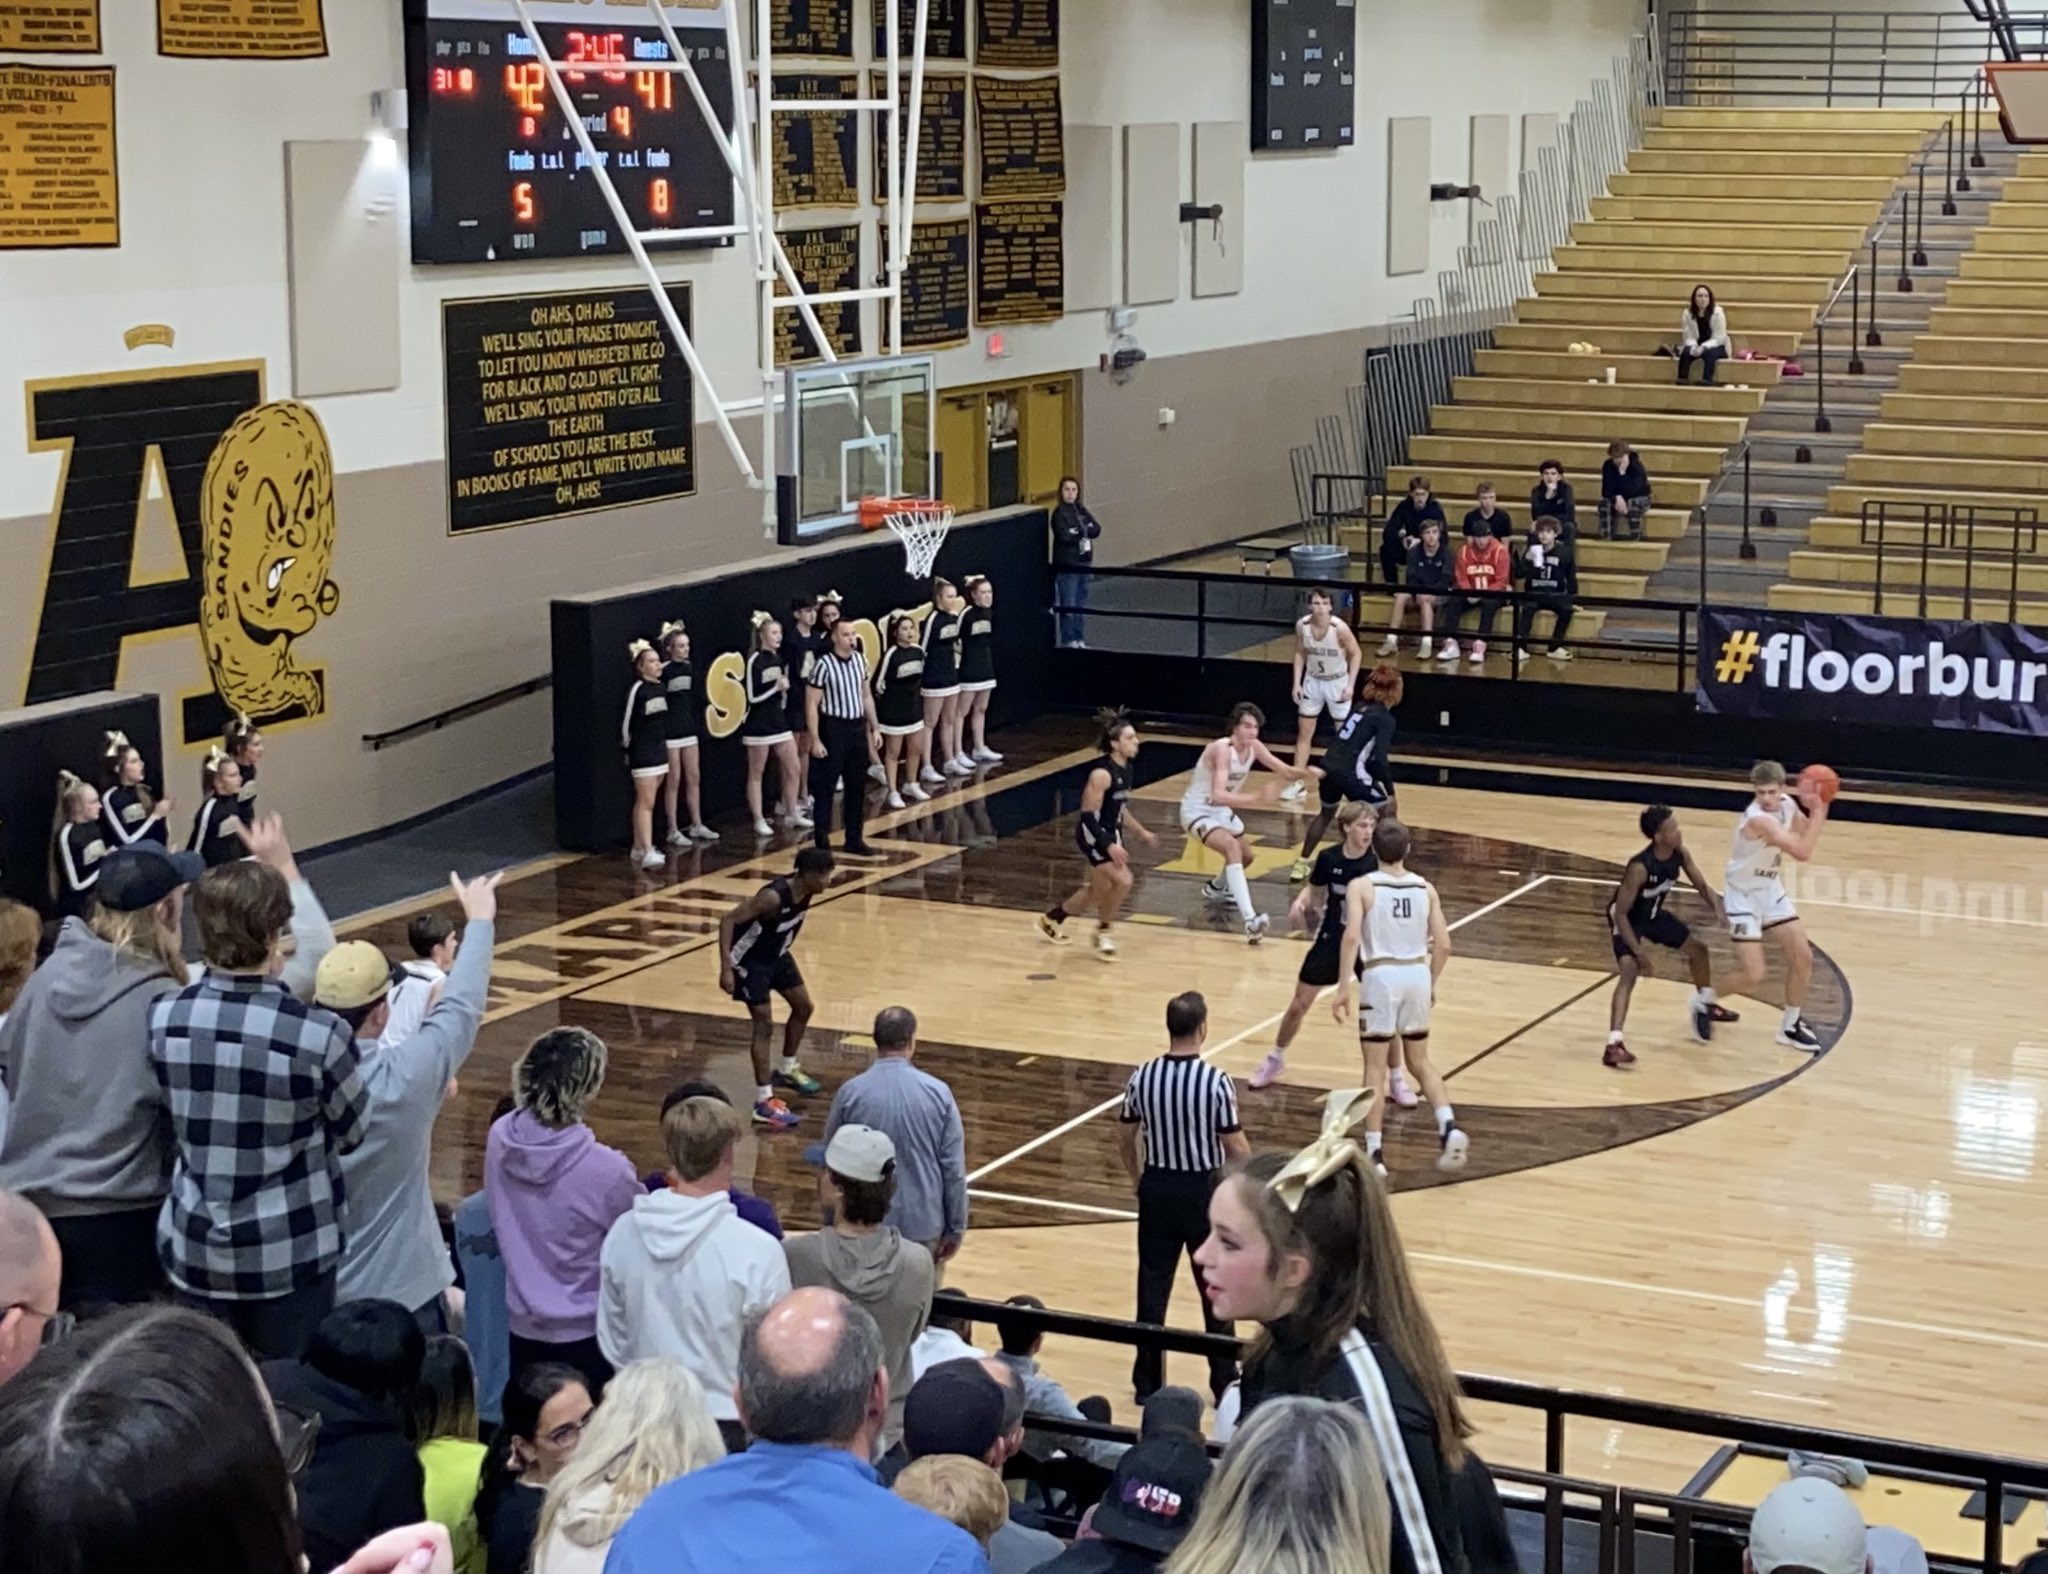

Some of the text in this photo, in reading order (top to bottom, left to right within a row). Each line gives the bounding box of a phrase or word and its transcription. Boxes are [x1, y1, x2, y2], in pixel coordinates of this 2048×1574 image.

[507, 62, 545, 111] 42
[639, 70, 671, 109] 41
[614, 106, 630, 136] 4
[516, 183, 533, 219] 5
[653, 179, 668, 213] 8
[531, 302, 614, 326] OH AHS, OH AHS
[482, 320, 660, 353] WE'LL SING YOUR PRAISE TONIGHT,
[478, 360, 494, 378] TO
[496, 357, 515, 376] LET
[517, 354, 541, 374] YOU
[542, 350, 576, 370] KNOW
[632, 343, 649, 360] WE
[650, 342, 665, 359] GO
[482, 382, 506, 400] FOR
[506, 377, 542, 398] BLACK
[544, 374, 566, 392] AND
[568, 370, 597, 389] GOLD
[598, 367, 629, 386] WE'LL
[484, 386, 662, 424] WE'LL SING YOUR WORTH O'ER ALL
[548, 414, 604, 438] THE EARTH
[494, 430, 656, 468] OF SCHOOLS YOU ARE THE BEST.
[457, 446, 686, 498] IN BOOKS OF FAME, WE'LL WRITE YOUR NAME
[556, 486, 576, 506] OH,
[215, 460, 249, 620] SANDIES
[1714, 630, 2048, 703] #floorbur
[1392, 897, 1411, 919] 20
